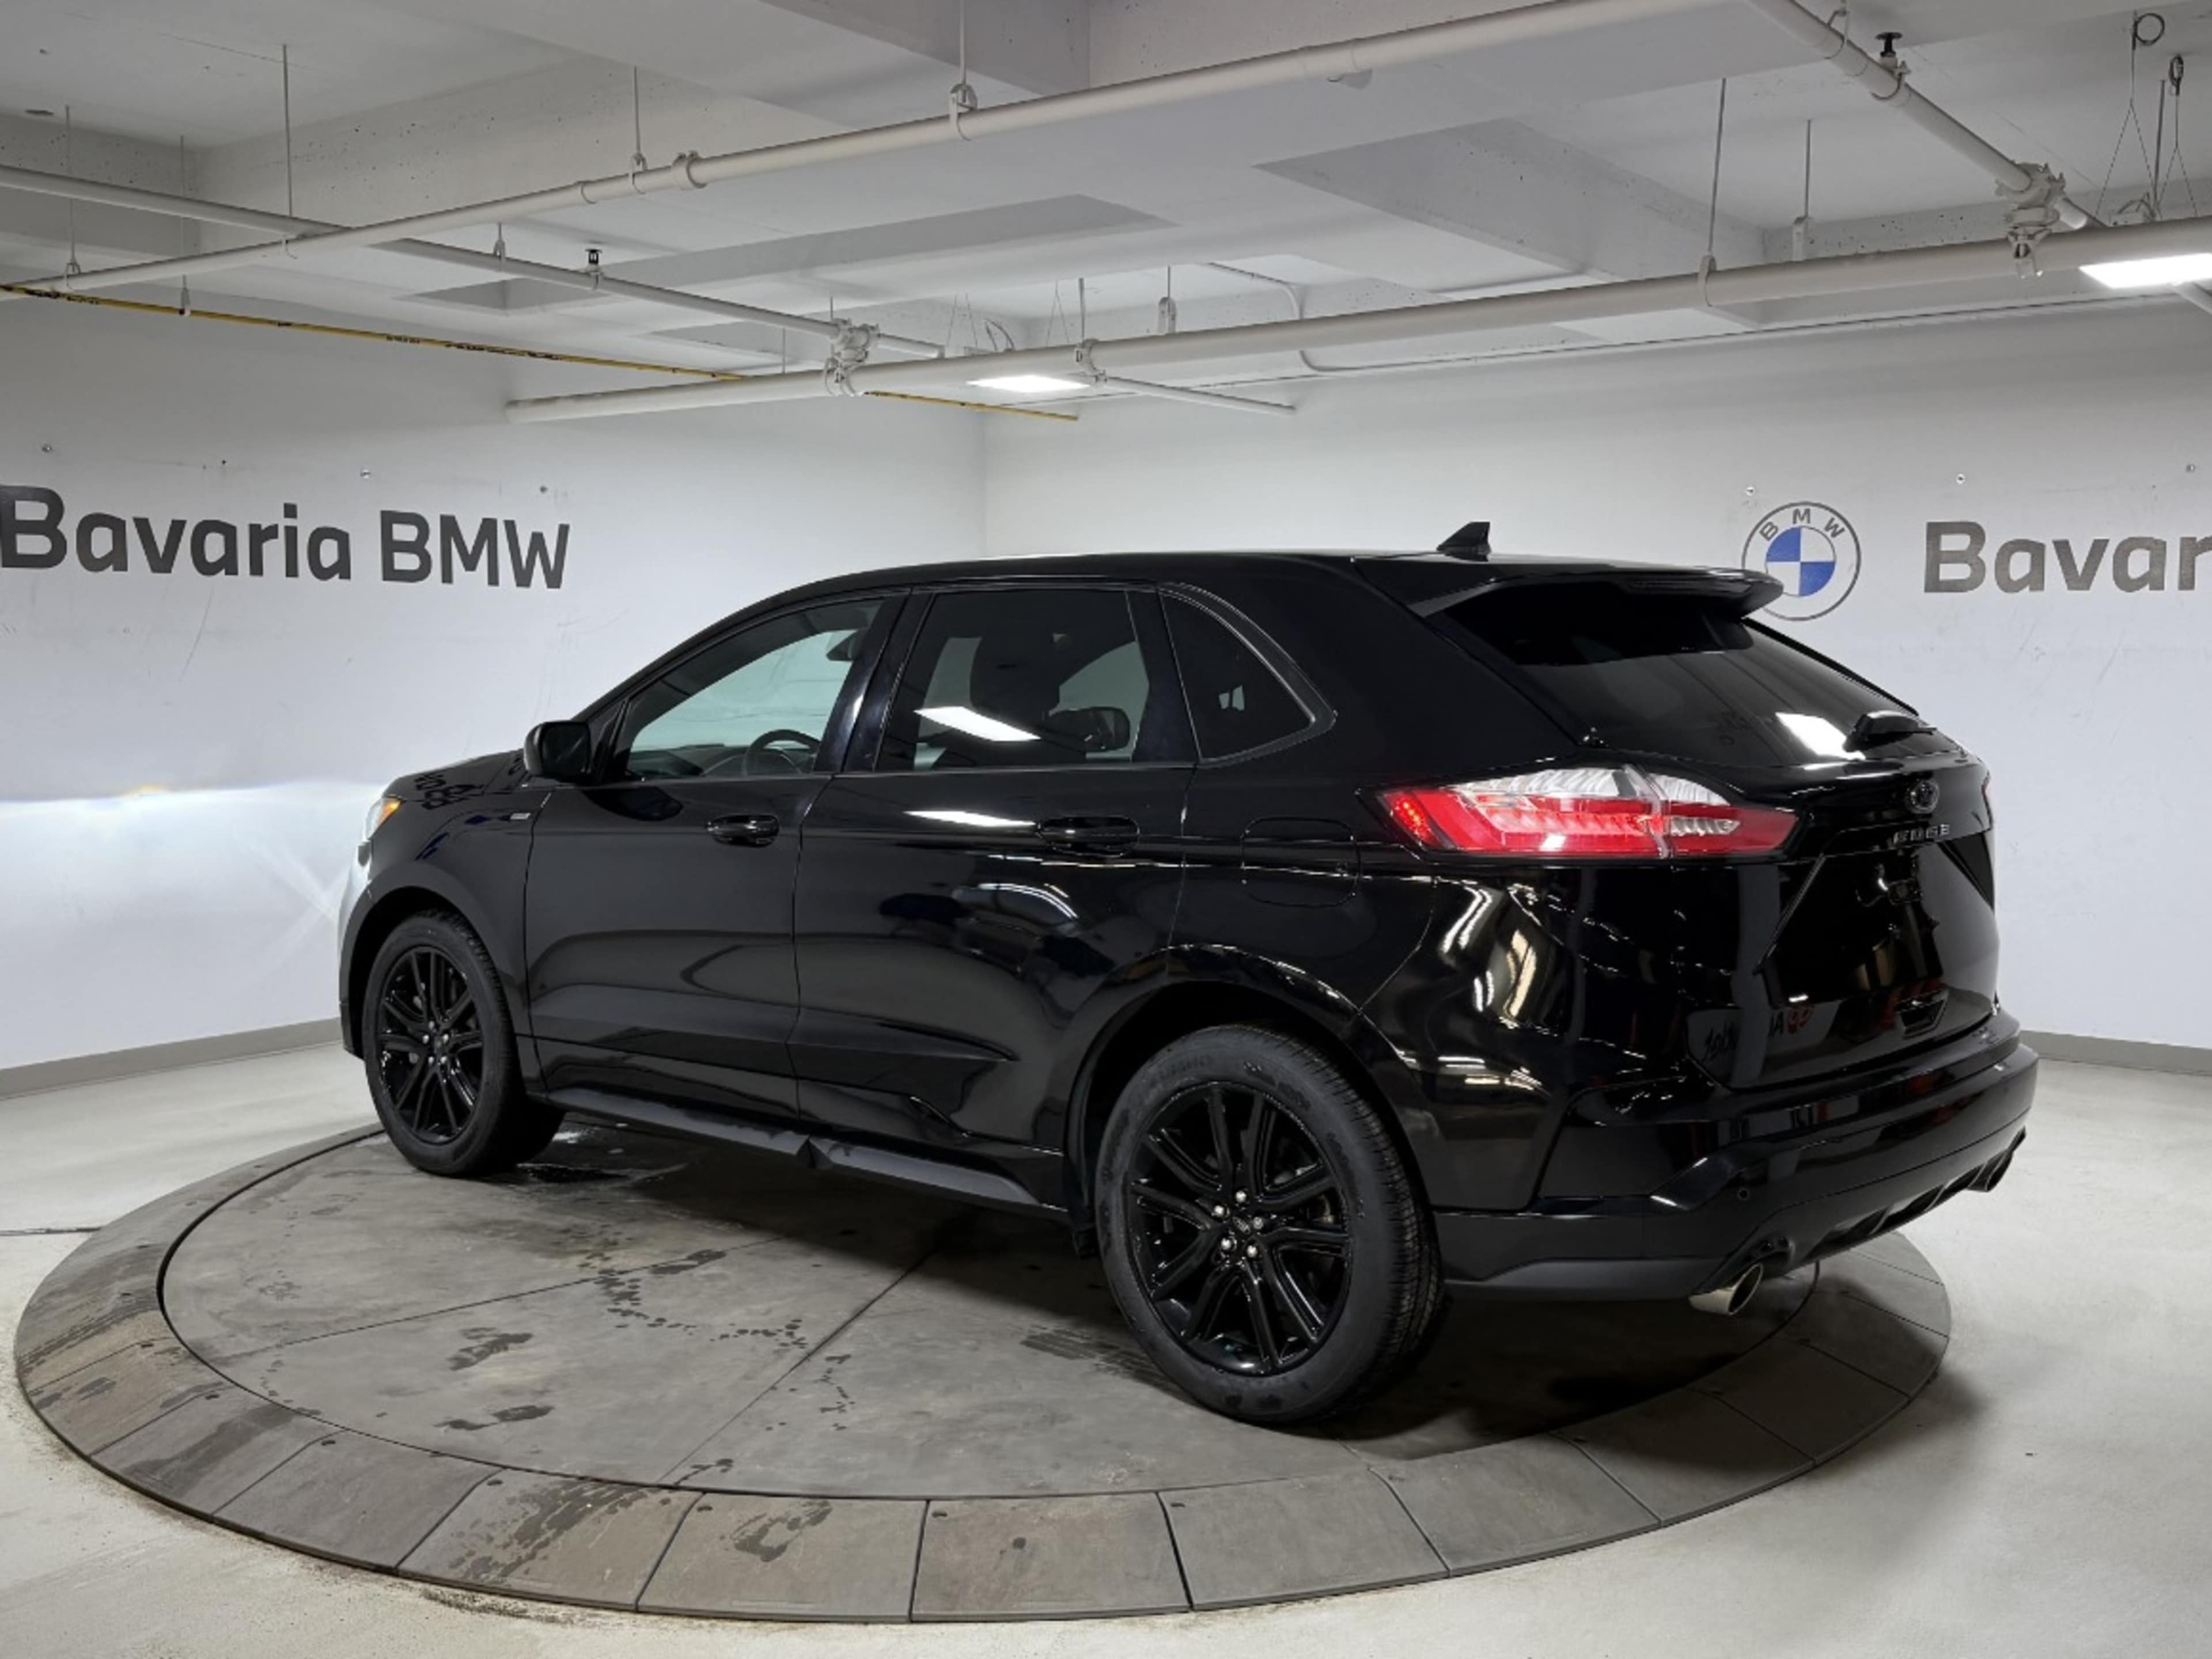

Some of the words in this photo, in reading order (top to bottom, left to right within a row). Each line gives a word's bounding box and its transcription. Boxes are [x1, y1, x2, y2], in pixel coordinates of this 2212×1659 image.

[0, 485, 351, 581] Bavaria
[380, 510, 570, 589] BMW
[1758, 507, 1846, 541] BMW
[1924, 521, 2212, 593] Bavar
